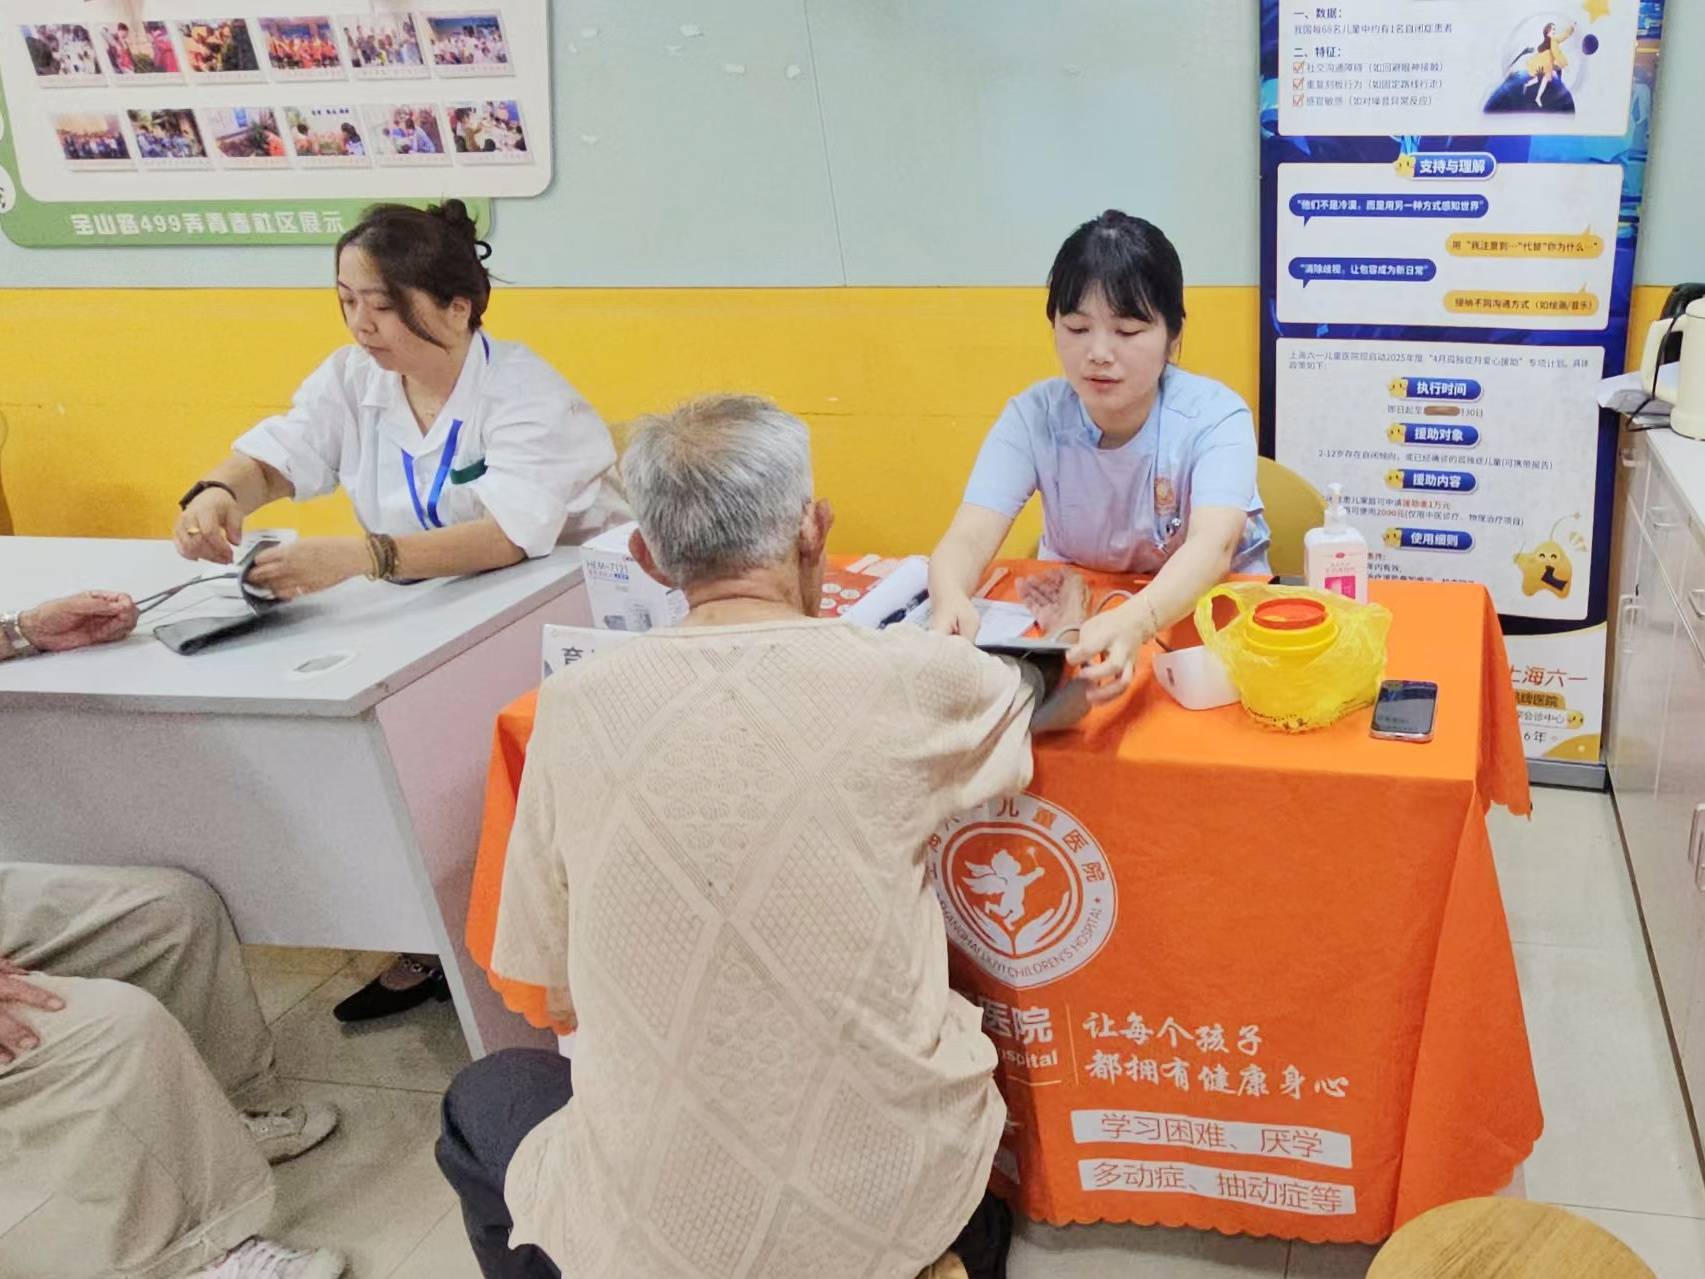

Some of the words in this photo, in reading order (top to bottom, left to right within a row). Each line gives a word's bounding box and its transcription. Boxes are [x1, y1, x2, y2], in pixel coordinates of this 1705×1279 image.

[1420, 159, 1486, 175] 支持与理解
[1417, 381, 1467, 396] 执行时间
[1415, 427, 1464, 442] 援助对象
[1413, 473, 1461, 488] 援助内容
[1411, 532, 1458, 547] 使用细则
[1511, 665, 1587, 687] 上海六一
[1082, 1011, 1263, 1057] 让每个孩子
[1085, 1047, 1349, 1100] 都拥有健康身心
[1101, 1113, 1323, 1158] 学习困难、厌学
[1094, 1162, 1343, 1214] 多动症、抽动症等
